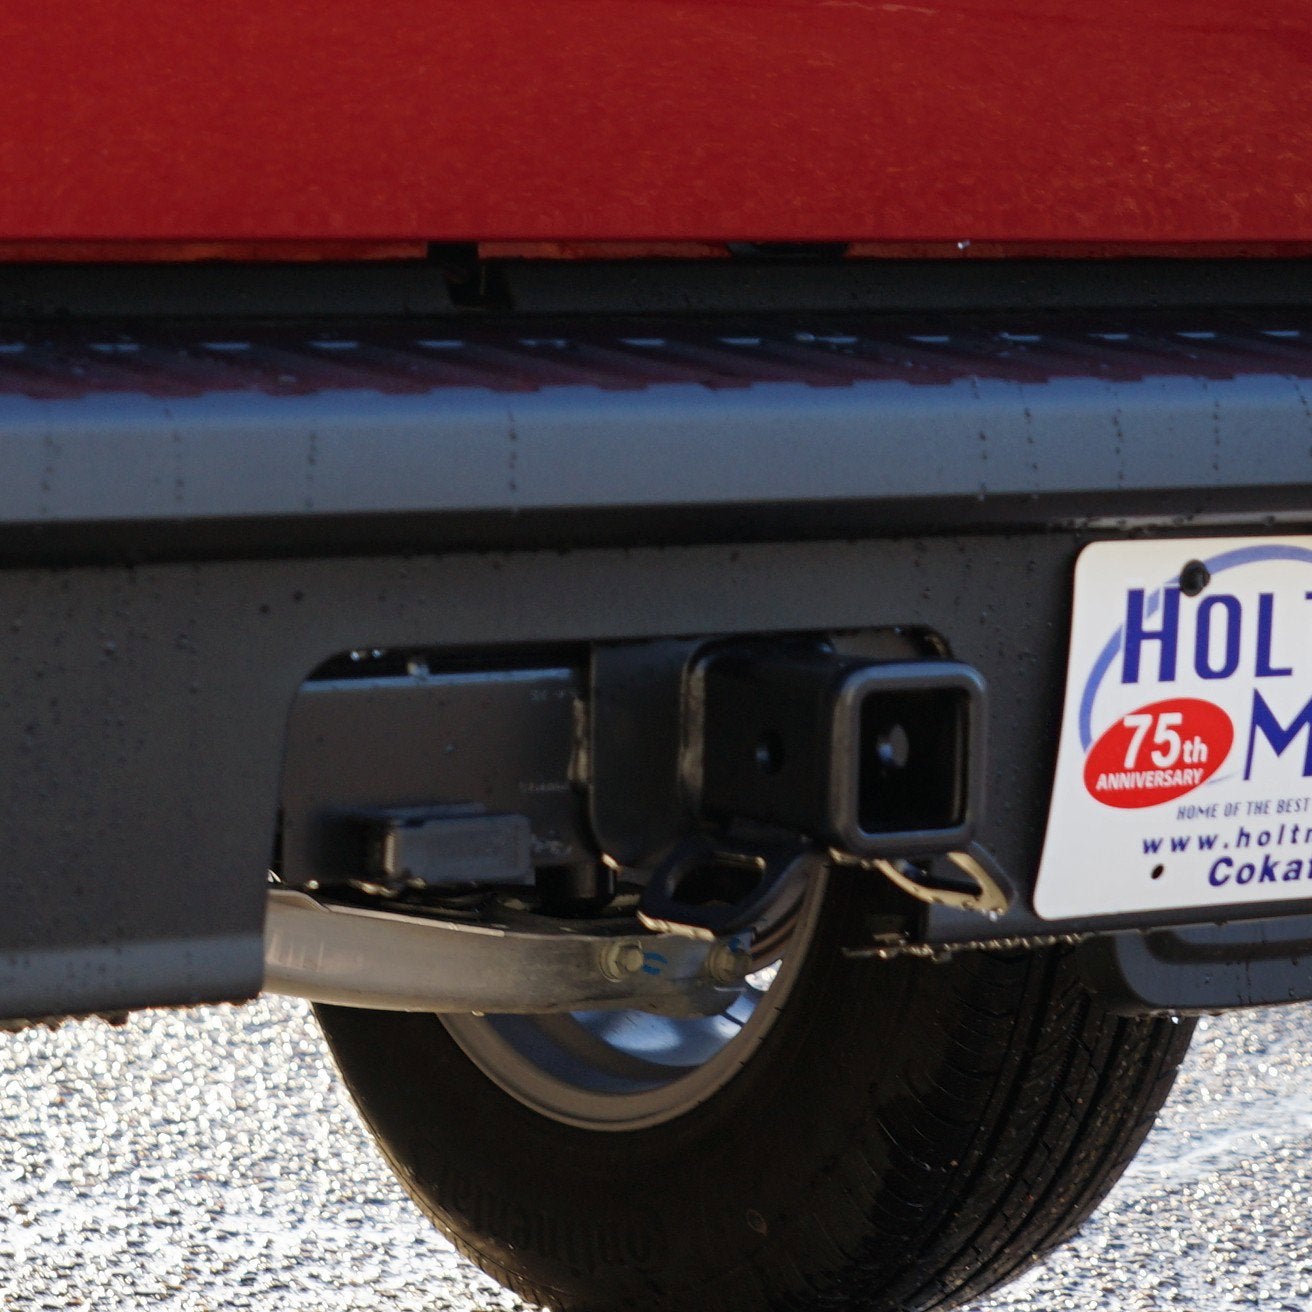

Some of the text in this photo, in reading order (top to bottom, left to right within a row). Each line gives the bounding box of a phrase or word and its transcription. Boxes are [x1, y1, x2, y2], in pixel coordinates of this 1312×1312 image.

[1123, 712, 1208, 769] 75th
[1096, 768, 1203, 790] ANNIVERSARY
[1177, 804, 1219, 820] HOME
[1224, 802, 1241, 817] OF
[1247, 800, 1271, 815] THE
[1277, 797, 1311, 813] BEST
